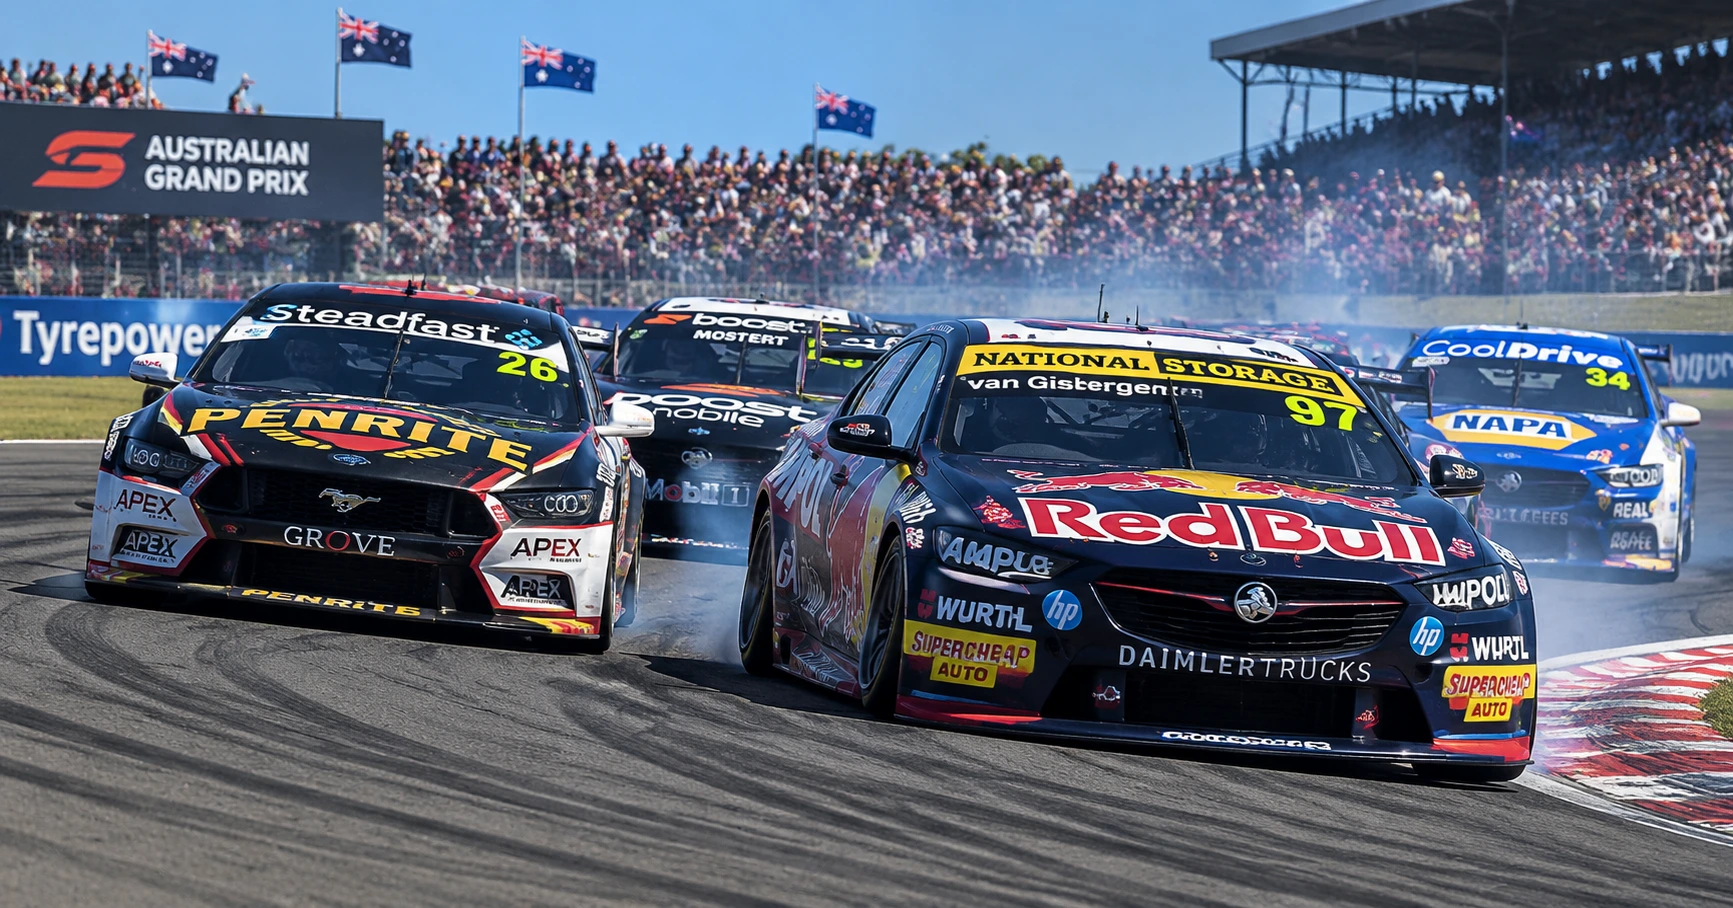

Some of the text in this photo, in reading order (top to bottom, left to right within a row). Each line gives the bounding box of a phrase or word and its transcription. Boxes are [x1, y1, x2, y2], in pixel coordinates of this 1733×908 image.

[145, 135, 309, 166] AUSTRALIAN
[145, 165, 309, 196] GRAND PRIX
[13, 310, 221, 367] Tyrepower
[260, 303, 499, 345] Steadfast
[692, 313, 805, 334] boost
[693, 329, 788, 346] MOSTERT
[496, 351, 559, 382] 26
[972, 351, 1150, 371] NATIONAL
[1423, 340, 1624, 369] CoolDrive
[967, 376, 1019, 390] van
[1165, 358, 1335, 394] STORAGE
[1586, 367, 1630, 390] 34
[1284, 395, 1358, 431] 97
[1453, 414, 1567, 438] NAPA
[187, 407, 533, 473] PENRITE
[113, 489, 177, 518] APEX
[1613, 501, 1650, 519] REAL
[120, 529, 178, 559] APEX
[284, 525, 396, 557] GROVE
[510, 537, 582, 557] APEX
[1046, 589, 1079, 630] hp
[912, 630, 1031, 668] SUPERCHEAP
[1412, 616, 1441, 656] hp
[937, 661, 989, 682] AUTO
[1471, 701, 1508, 718] AUTO
